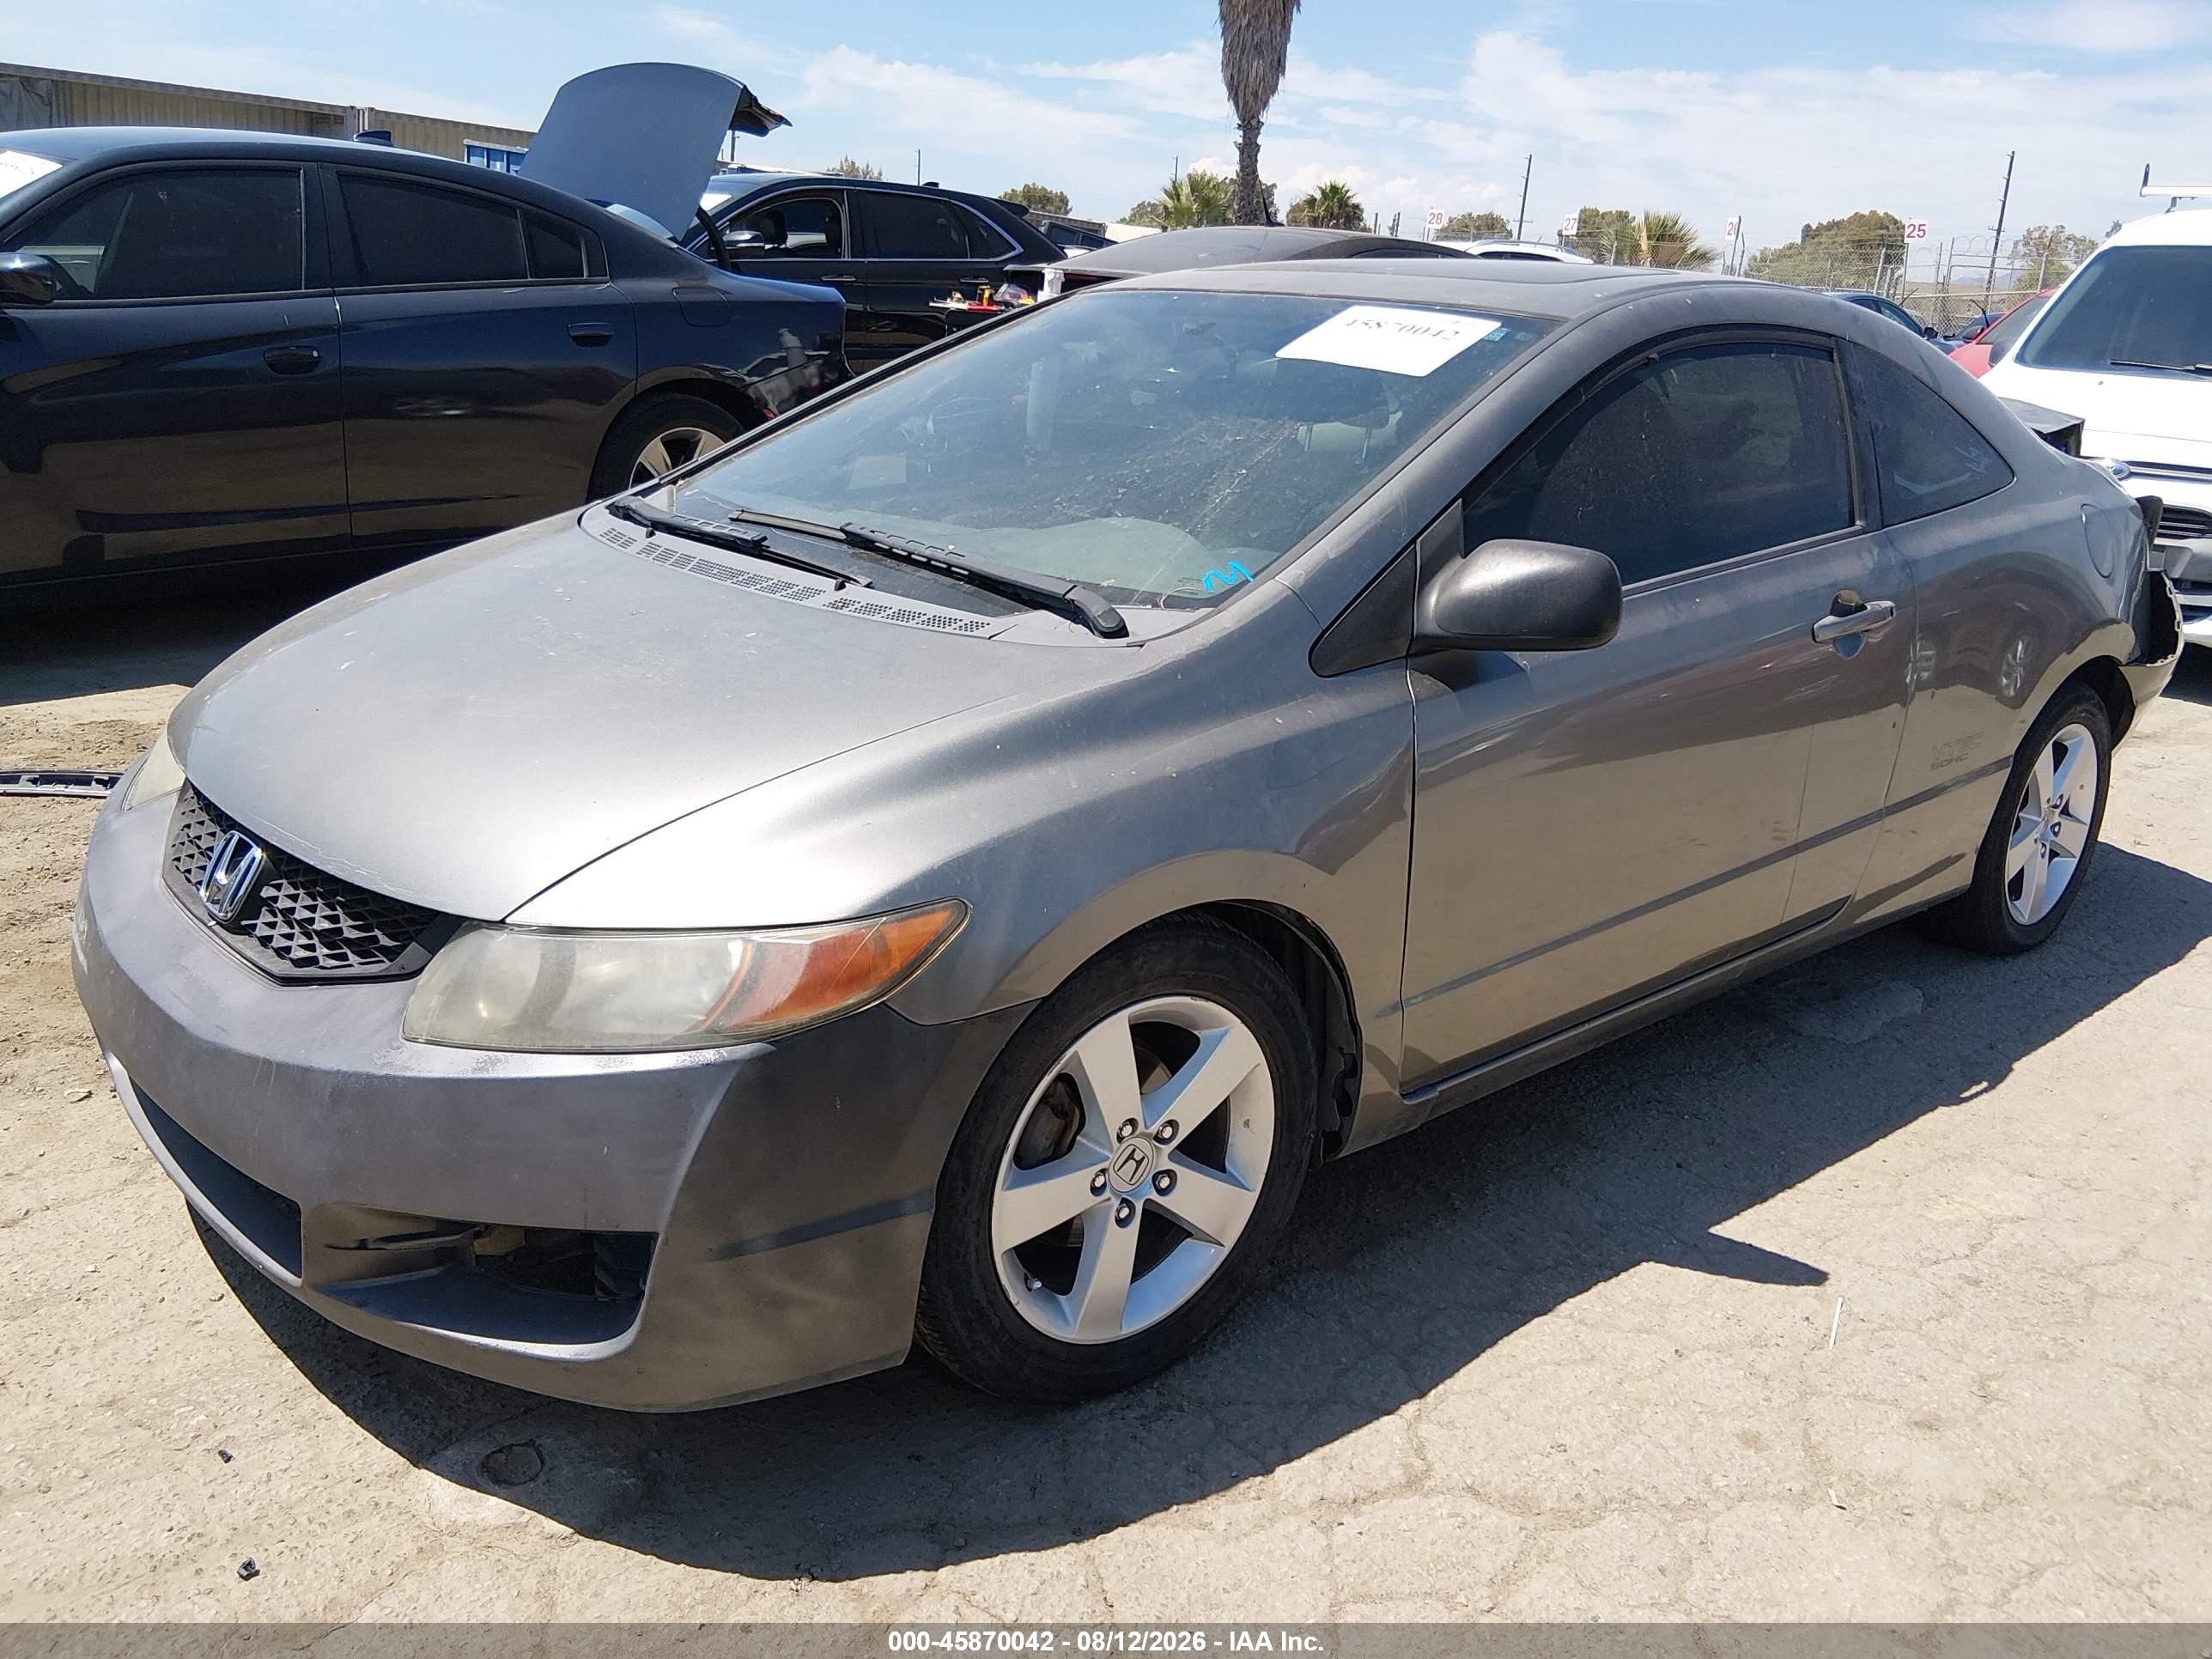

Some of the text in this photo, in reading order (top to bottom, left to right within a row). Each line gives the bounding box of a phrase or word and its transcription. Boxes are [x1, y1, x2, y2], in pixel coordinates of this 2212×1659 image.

[1564, 217, 1577, 231] 27
[1905, 223, 1927, 239] 25
[1930, 731, 1985, 762] VTEC
